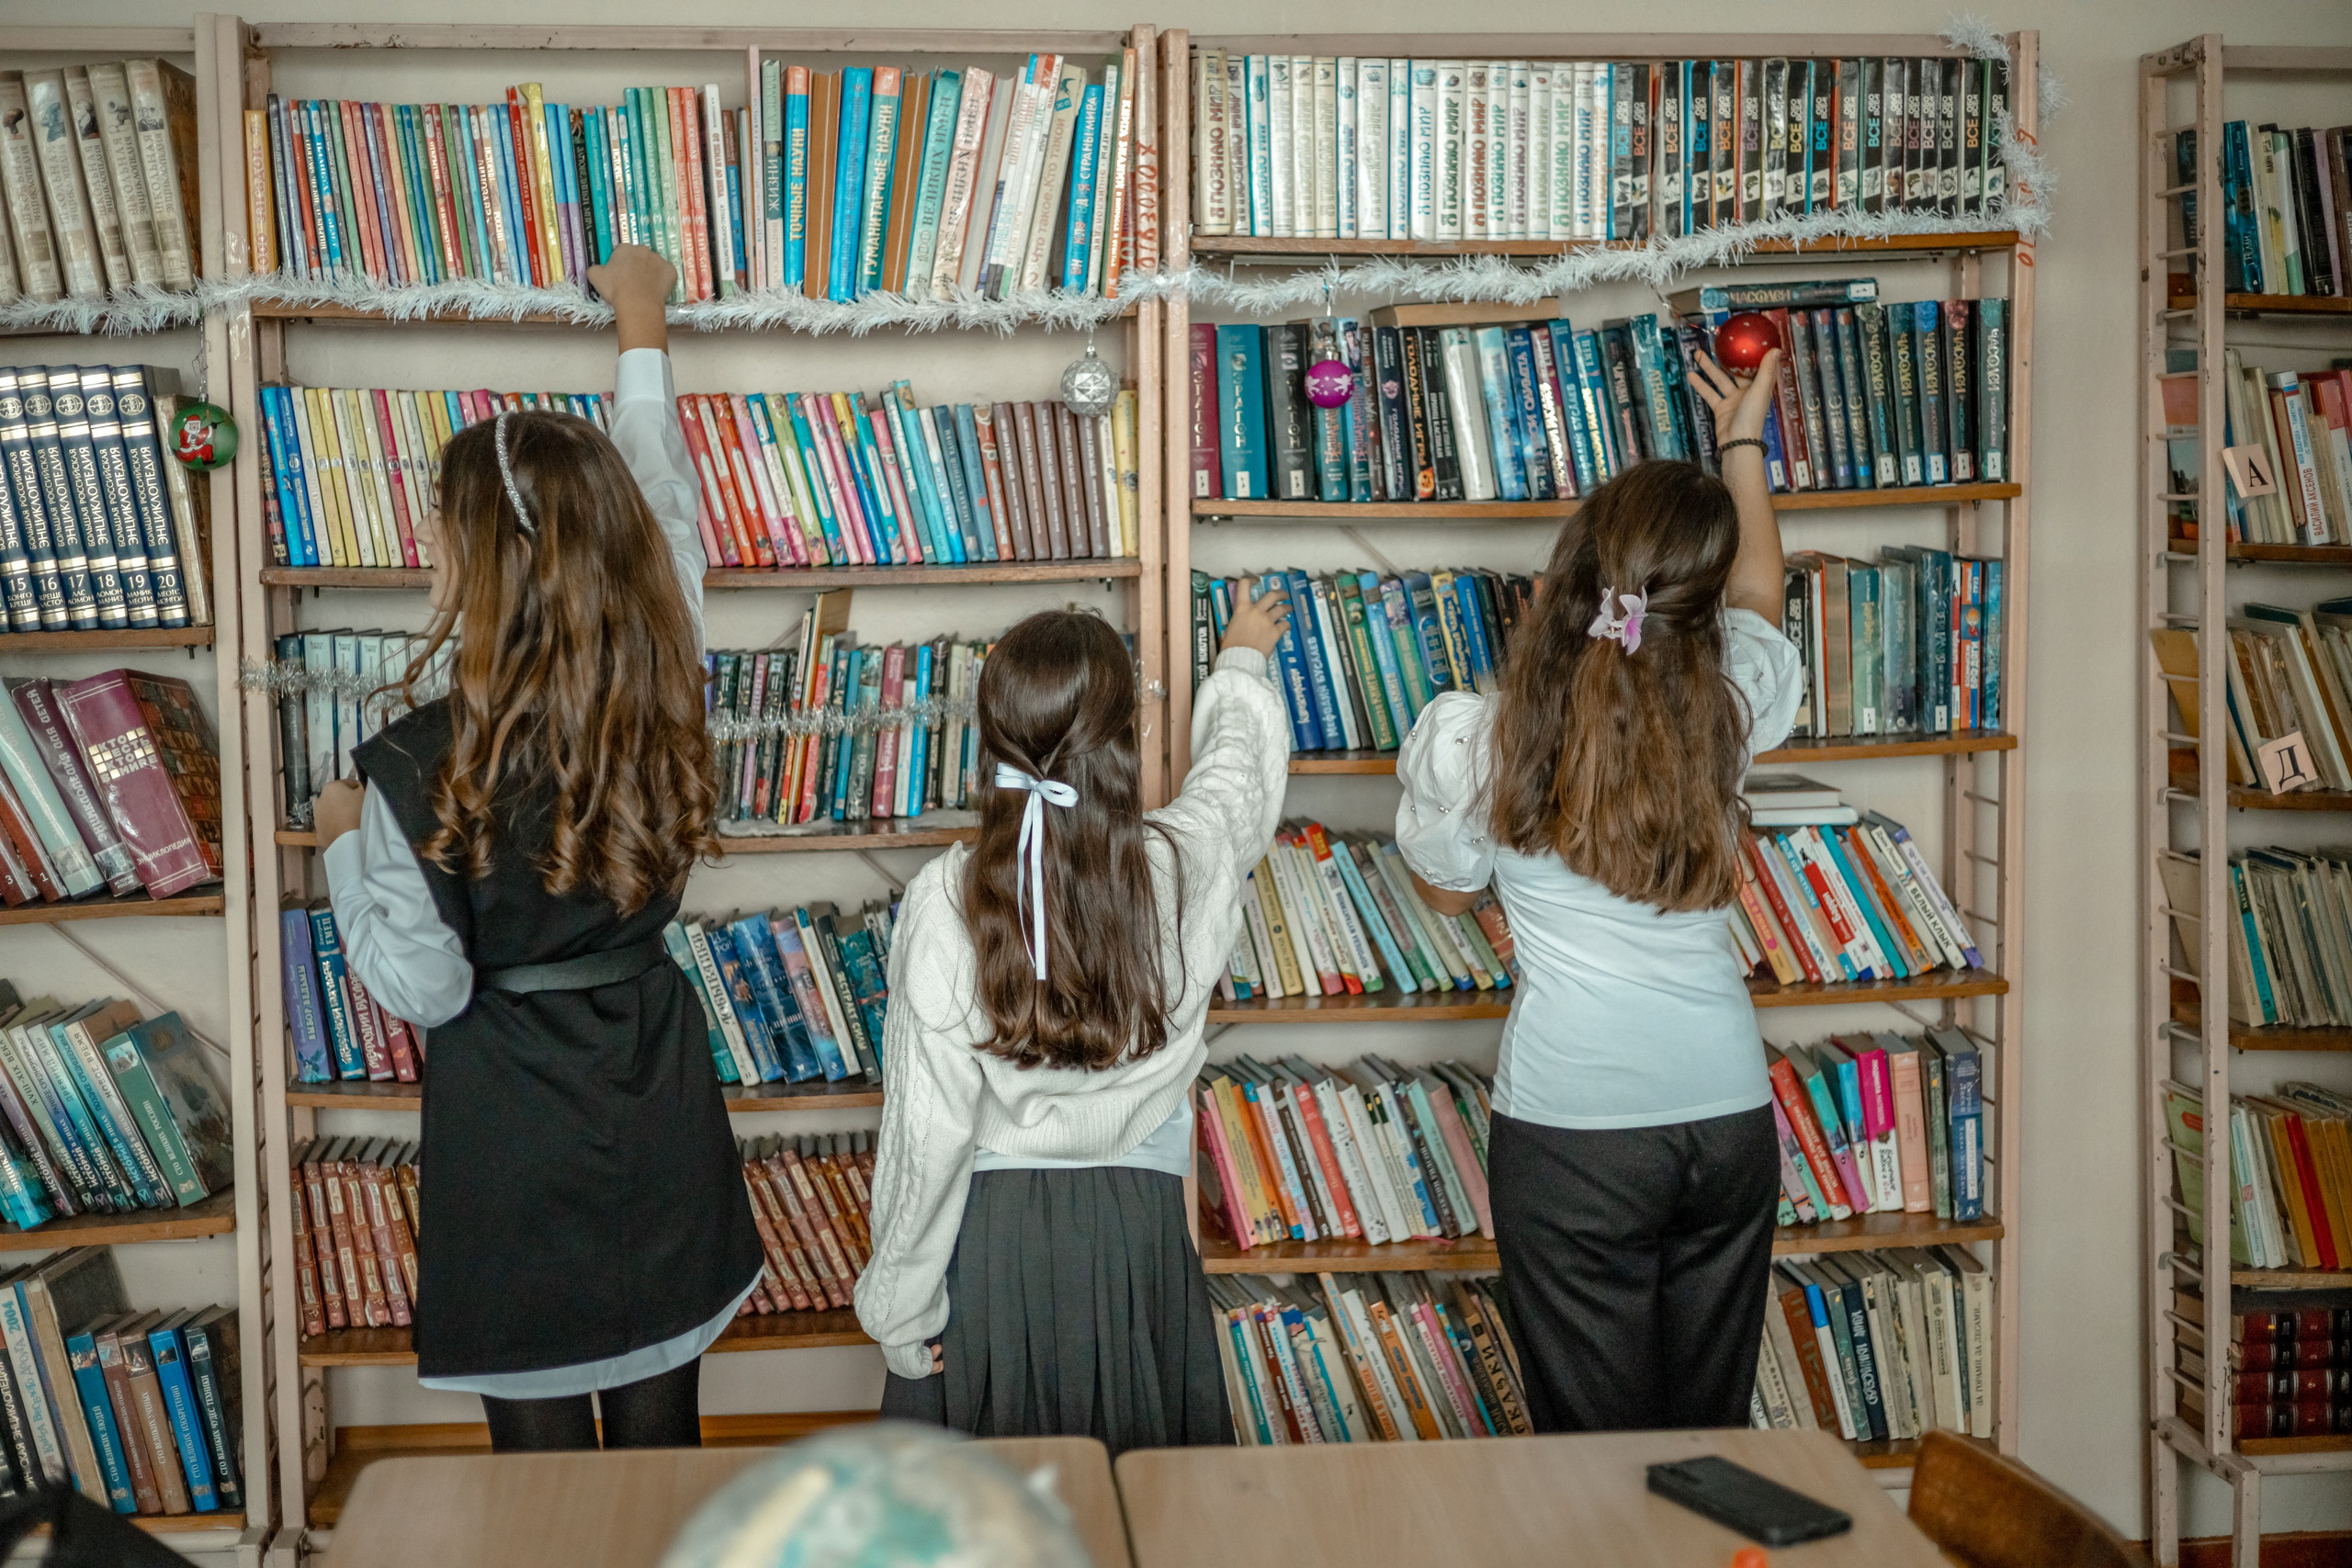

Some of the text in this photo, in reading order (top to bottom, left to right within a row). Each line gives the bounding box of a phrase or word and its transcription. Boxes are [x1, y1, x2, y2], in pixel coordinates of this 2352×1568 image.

[1085, 96, 1098, 130] МИРА
[1419, 106, 1431, 137] МИР
[1443, 96, 1459, 135] МИР
[1471, 97, 1486, 134] МИР
[1577, 107, 1591, 141] МИР
[1694, 122, 1707, 152] ВСЕ
[1815, 121, 1827, 151] ВСЕ
[1868, 118, 1880, 147] ВСЕ
[1967, 118, 1978, 148] ВСЕ
[94, 144, 115, 215] ЭНЦИКЛОПЕДИЯ
[115, 137, 138, 215] ШКОЛЬНАЯ
[124, 136, 148, 214] ЭНЦИКЛОПЕДИЯ
[142, 134, 164, 214] ШКОЛЬНАЯ
[153, 133, 174, 213] ЭНЦИКЛОПЕДИЯ
[918, 96, 952, 263] 100 ВЕЛИКИХ ИМЕН
[1080, 132, 1094, 179] СТРАНЫ
[1208, 85, 1225, 219] Я ПОЗНАЮ МИР
[1418, 141, 1430, 200] ПОЗНАЮ
[1442, 140, 1458, 209] ПОЗНАЮ
[1470, 140, 1486, 209] ПОЗНАЮ
[1575, 144, 1590, 209] ПОЗНАЮ
[768, 159, 780, 211] ЖИЗНИ
[789, 128, 805, 242] ТОЧНЫЕ НАУКИ
[864, 105, 893, 276] ГУМАНИТАРНЫЕ НАУКИ
[1406, 336, 1427, 466] ГОЛОДНЫЕ ИГРЫ
[9, 449, 37, 551] БОЛЬШАЯ РОССИЙСКАЯ
[19, 449, 50, 549] ЭНЦИКЛОПЕДИЯ
[38, 448, 65, 547] БОЛЬШАЯ РОССИЙСКАЯ
[48, 447, 78, 547] ЭНЦИКЛОПЕДИЯ
[69, 448, 96, 547] БОЛЬШАЯ РОССИЙСКАЯ
[79, 446, 108, 546] ЭНЦИКЛОПЕДИЯ
[99, 448, 126, 547] БОЛЬШАЯ РОССИЙСКАЯ
[109, 446, 140, 546] ЭНЦИКЛОПЕДИЯ
[130, 448, 156, 547] БОЛЬШАЯ РОССИЙСКАЯ
[140, 446, 169, 546] ЭНЦИКЛОПЕДИЯ
[2248, 457, 2269, 488] А
[2303, 468, 2324, 536] ВАСИЛИЙ АКСЕНОВ
[8, 578, 27, 592] 15
[39, 577, 57, 592] 16
[68, 574, 85, 589] 17
[97, 574, 115, 588] 18
[128, 574, 145, 588] 19
[157, 576, 175, 587] 20
[1307, 636, 1327, 682] БУСЛАЕВ
[26, 688, 108, 841] ЭНЦИКЛОПЕДИЯ ДЛЯ ДЕТЕЙ
[100, 735, 126, 751] КТО
[107, 753, 136, 771] КТО
[110, 738, 150, 760] ЕСТЬ
[119, 753, 158, 776] МИРЕ
[2275, 744, 2308, 790] Д
[1336, 891, 1369, 969] КОРОЛЕВА МУТАНТИКОВ
[1822, 892, 1842, 924] Барри
[1910, 886, 1953, 949] БЕЛЫЙ КЛЫК
[297, 964, 317, 1040] ВЫБОР ВЕДЬМЫ
[838, 971, 867, 1050] ЭКСТРАКТ СИЛЫ
[0, 1038, 40, 1105] XVIII-XIX ВЕКА
[36, 1036, 50, 1056] МИР
[57, 1032, 90, 1082] СРЕДНЕВЕКОВЬЕ
[74, 1032, 113, 1099] НОВОЕ ВРЕМЯ
[44, 1090, 61, 1115] РАННЕЕ
[46, 1057, 74, 1101] ДРЕВНИЙ
[74, 1146, 98, 1187] ИСТОРИЯ
[93, 1146, 117, 1187] ИСТОРИЯ
[142, 1100, 184, 1176] СТО ВЕЛИКИХ РОССИЯН
[2, 1301, 22, 1334] 2004
[92, 1405, 119, 1482] СТО ВЕЛИКИХ ЛЮДЕЙ
[141, 1392, 165, 1464] СТО ВЕЛИКИХ УЧЕНЫХ
[170, 1384, 201, 1478] СТО ВЕЛИКИХ ИЗОБРЕТЕНИЙ
[200, 1374, 228, 1475] СТО ВЕЛИКИХ ЧУДЕС ТЕХНИКИ
